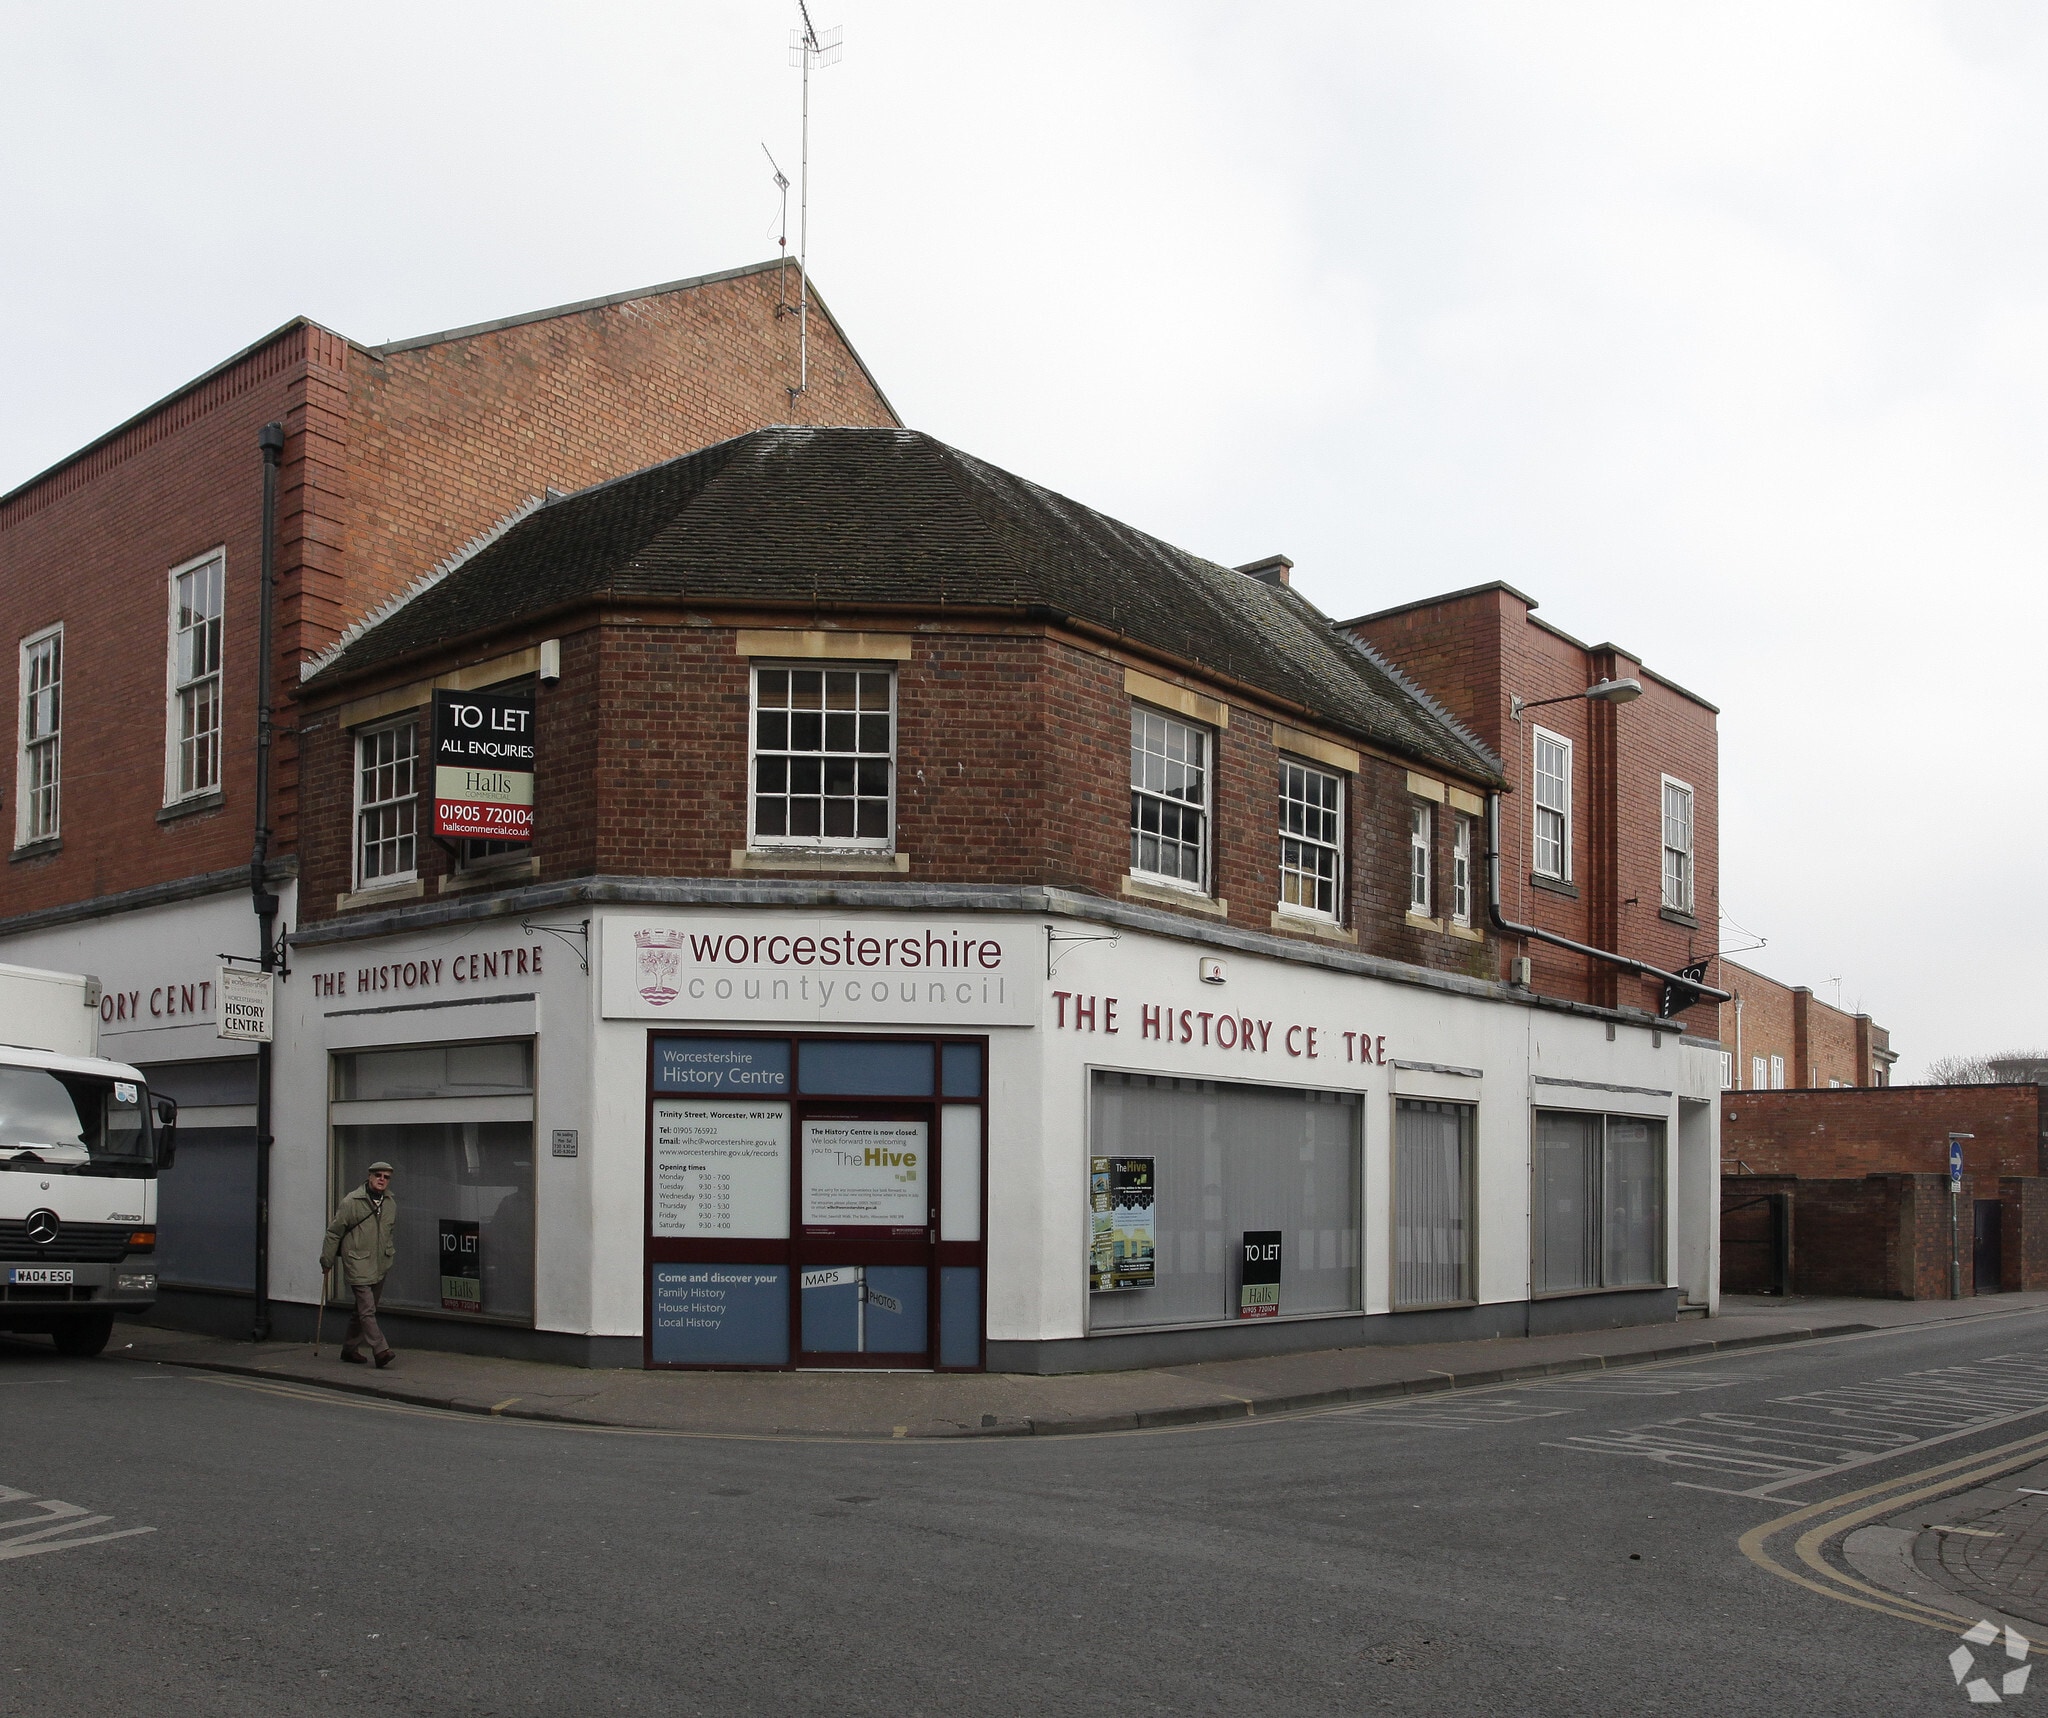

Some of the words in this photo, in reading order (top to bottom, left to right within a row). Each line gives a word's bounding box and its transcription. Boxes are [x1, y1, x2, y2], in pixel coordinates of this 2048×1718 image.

[450, 704, 483, 728] TO
[491, 707, 530, 732] LET
[441, 739, 464, 753] ALL
[468, 741, 534, 758] ENQUIRIES
[466, 771, 511, 793] Halls
[465, 790, 510, 801] COMMERCIAL
[440, 804, 480, 821] 01905
[486, 807, 534, 825] 720104
[443, 822, 529, 836] hallscommercial.co.uk
[689, 929, 1002, 969] worcestershire
[312, 971, 345, 997] THE
[357, 959, 442, 993] HISTORY
[452, 945, 543, 983] CENTRE
[688, 975, 1004, 1007] countycouncil
[100, 990, 139, 1022] ORY
[150, 981, 216, 1016] CENT
[225, 1003, 265, 1017] HISTORY
[225, 1017, 265, 1032] CENTRE
[1053, 990, 1120, 1033] THE
[1141, 1003, 1273, 1052] HISTORY
[663, 1050, 752, 1064] Worcestershire
[663, 1066, 723, 1088] History
[728, 1067, 785, 1084] Centre
[659, 1111, 682, 1120] Trinity
[684, 1111, 708, 1119] Street,
[710, 1111, 748, 1120] Worcester,
[873, 1138, 907, 1147] welcoming
[659, 1149, 779, 1158] www.worcestershire.gov.uk/records
[659, 1164, 687, 1172] Opening
[659, 1212, 678, 1220] Friday
[441, 1233, 457, 1252] TO
[460, 1234, 478, 1253] LET
[1245, 1245, 1260, 1261] TO
[1262, 1244, 1280, 1261] LET
[17, 1270, 47, 1282] WA04
[51, 1270, 72, 1282] ESG
[658, 1273, 687, 1283] Come
[689, 1272, 708, 1283] and
[710, 1272, 752, 1283] discover
[754, 1275, 778, 1285] your
[805, 1271, 839, 1286] MAPS
[449, 1280, 473, 1299] Halls
[658, 1287, 688, 1300] Family
[691, 1288, 726, 1300] History
[1249, 1287, 1272, 1304] Halls
[869, 1291, 897, 1311] PHOTOS
[658, 1303, 689, 1313] House
[691, 1303, 726, 1315] History
[658, 1318, 684, 1327] Local
[686, 1318, 721, 1330] History
